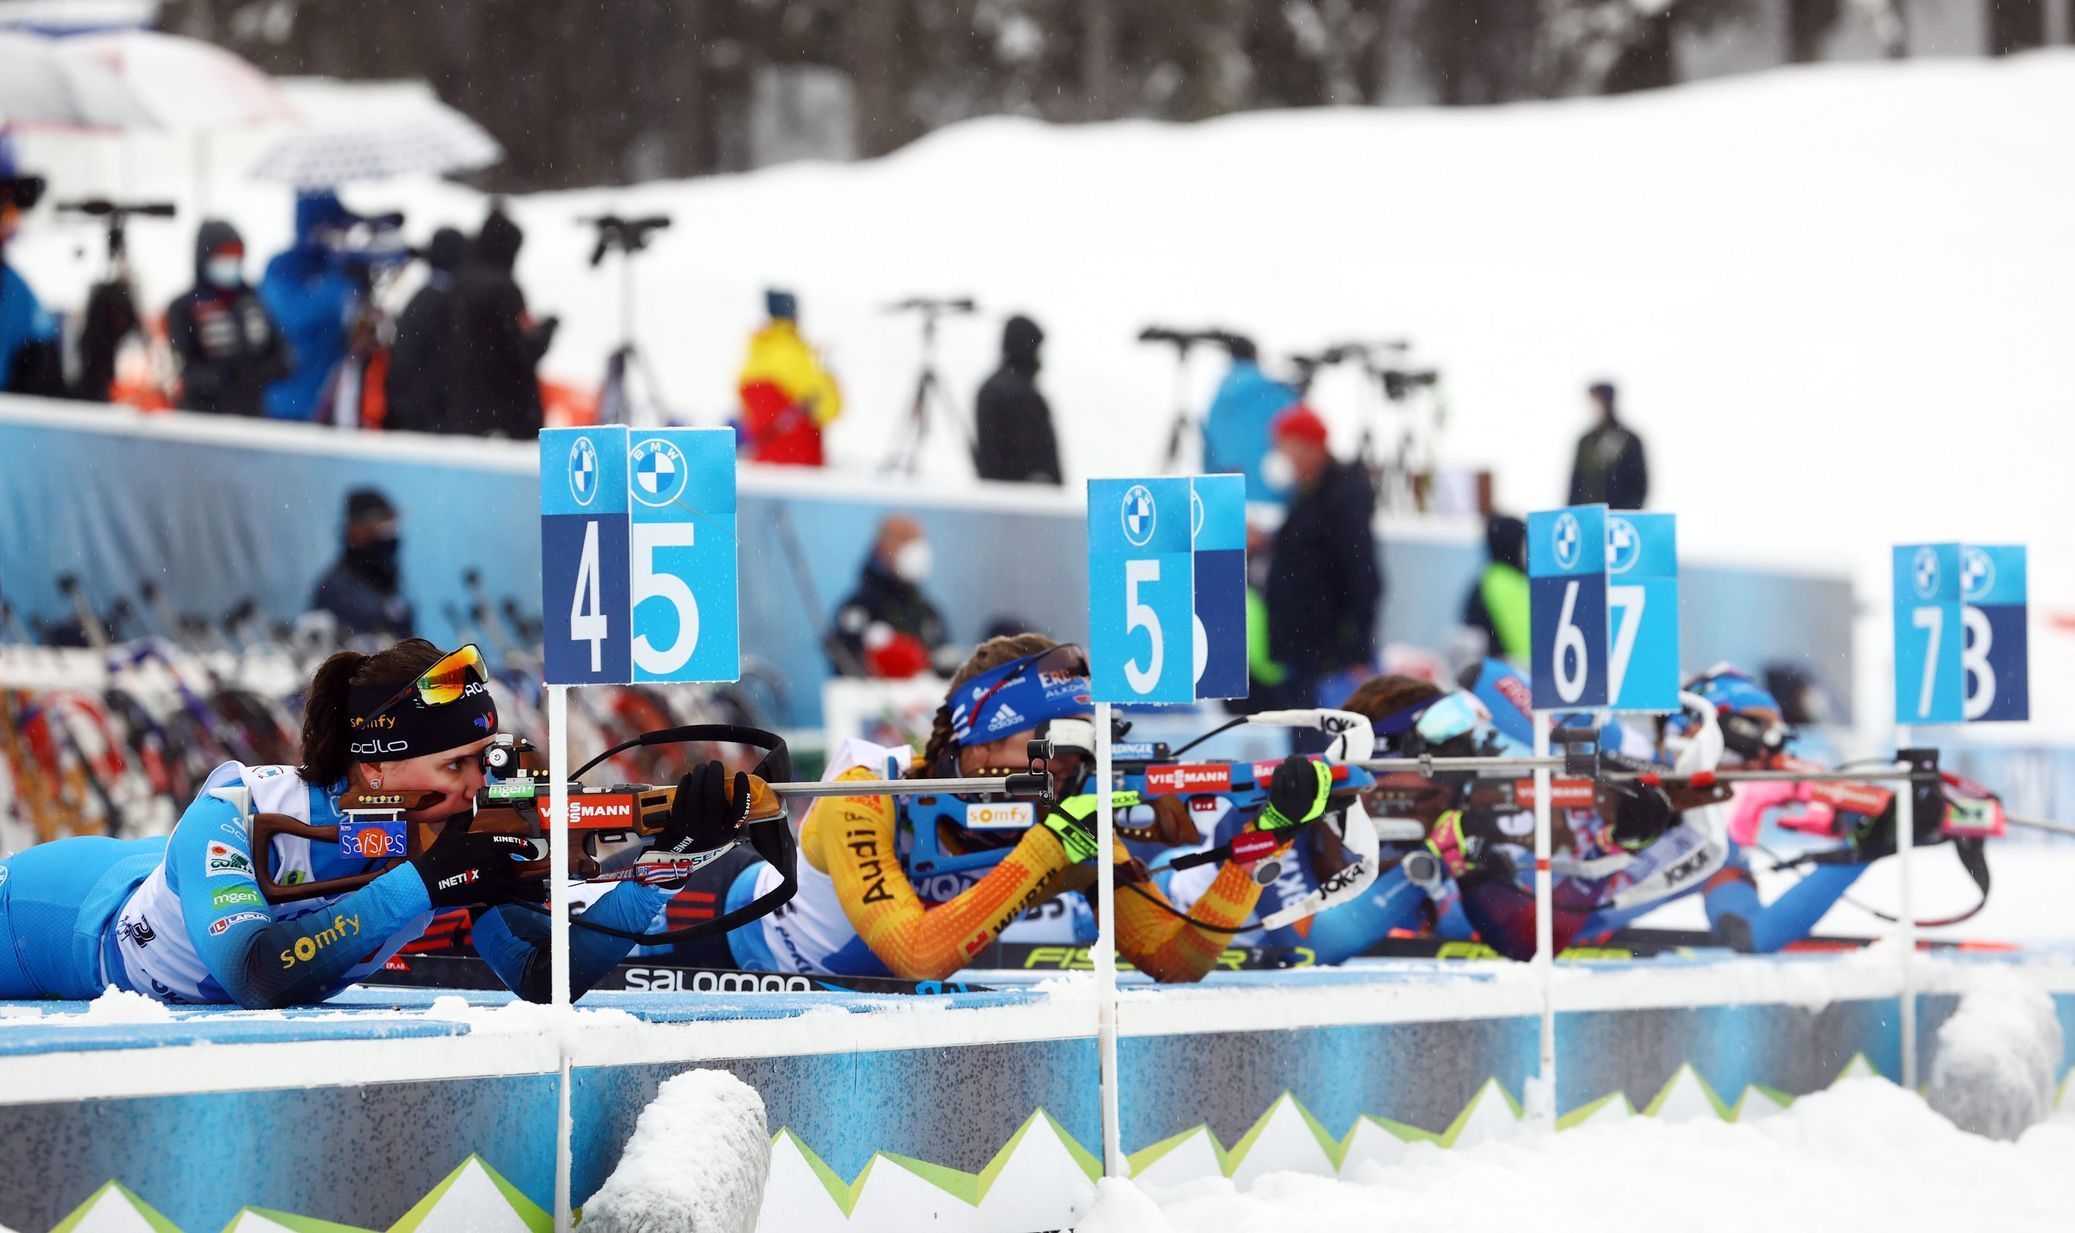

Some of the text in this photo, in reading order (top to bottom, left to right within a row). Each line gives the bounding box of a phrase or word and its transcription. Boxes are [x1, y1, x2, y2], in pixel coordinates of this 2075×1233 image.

[633, 442, 679, 462] BMW
[571, 521, 607, 672] 4
[633, 522, 699, 674] 5
[1124, 559, 1164, 695] 5
[1553, 580, 1588, 703] 6
[1609, 585, 1646, 706] 7
[1912, 606, 1942, 719] 7
[988, 714, 1024, 732] adidas
[350, 739, 409, 754] odlo
[1148, 768, 1228, 789] VIESSMANN
[540, 801, 630, 823] VSSMANN
[970, 807, 1028, 823] somfy
[847, 830, 894, 905] Audi
[213, 890, 257, 906] mgen
[280, 913, 361, 970] somfy
[625, 967, 811, 993] salomon
